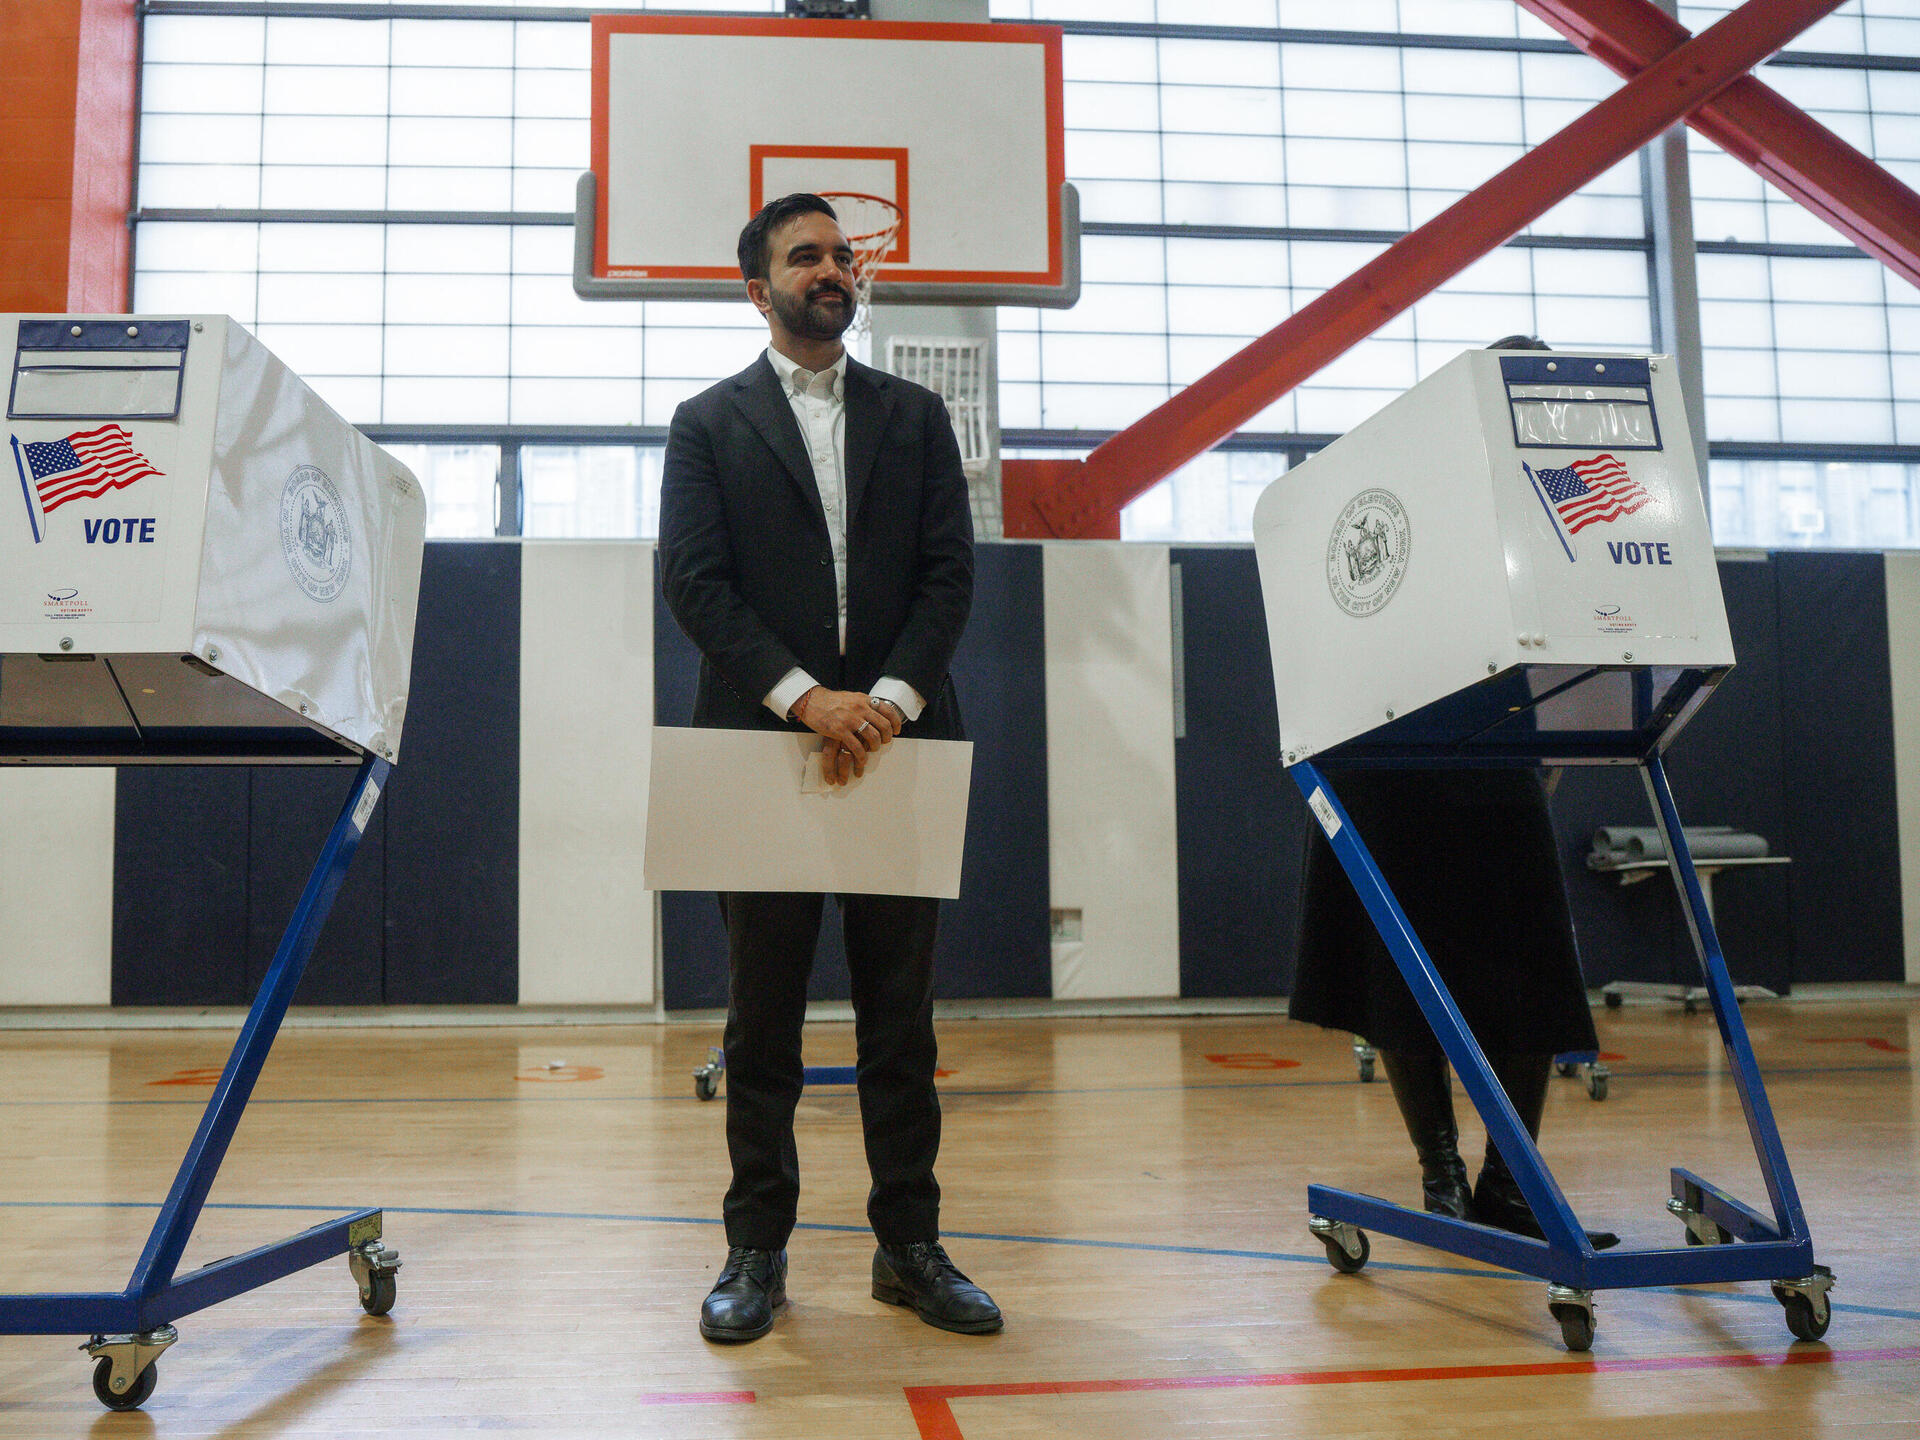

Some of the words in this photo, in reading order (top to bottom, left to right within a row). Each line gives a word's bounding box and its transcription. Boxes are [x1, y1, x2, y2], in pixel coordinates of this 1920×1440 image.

[84, 518, 156, 544] VOTE
[1330, 519, 1346, 562] BOARD
[1345, 503, 1357, 519] OF
[1357, 493, 1400, 518] ELECTIONS
[1351, 600, 1371, 611] CITY
[1371, 592, 1384, 607] OF
[1384, 568, 1401, 595] NEW
[1398, 528, 1407, 564] YORK
[1607, 541, 1672, 565] VOTE
